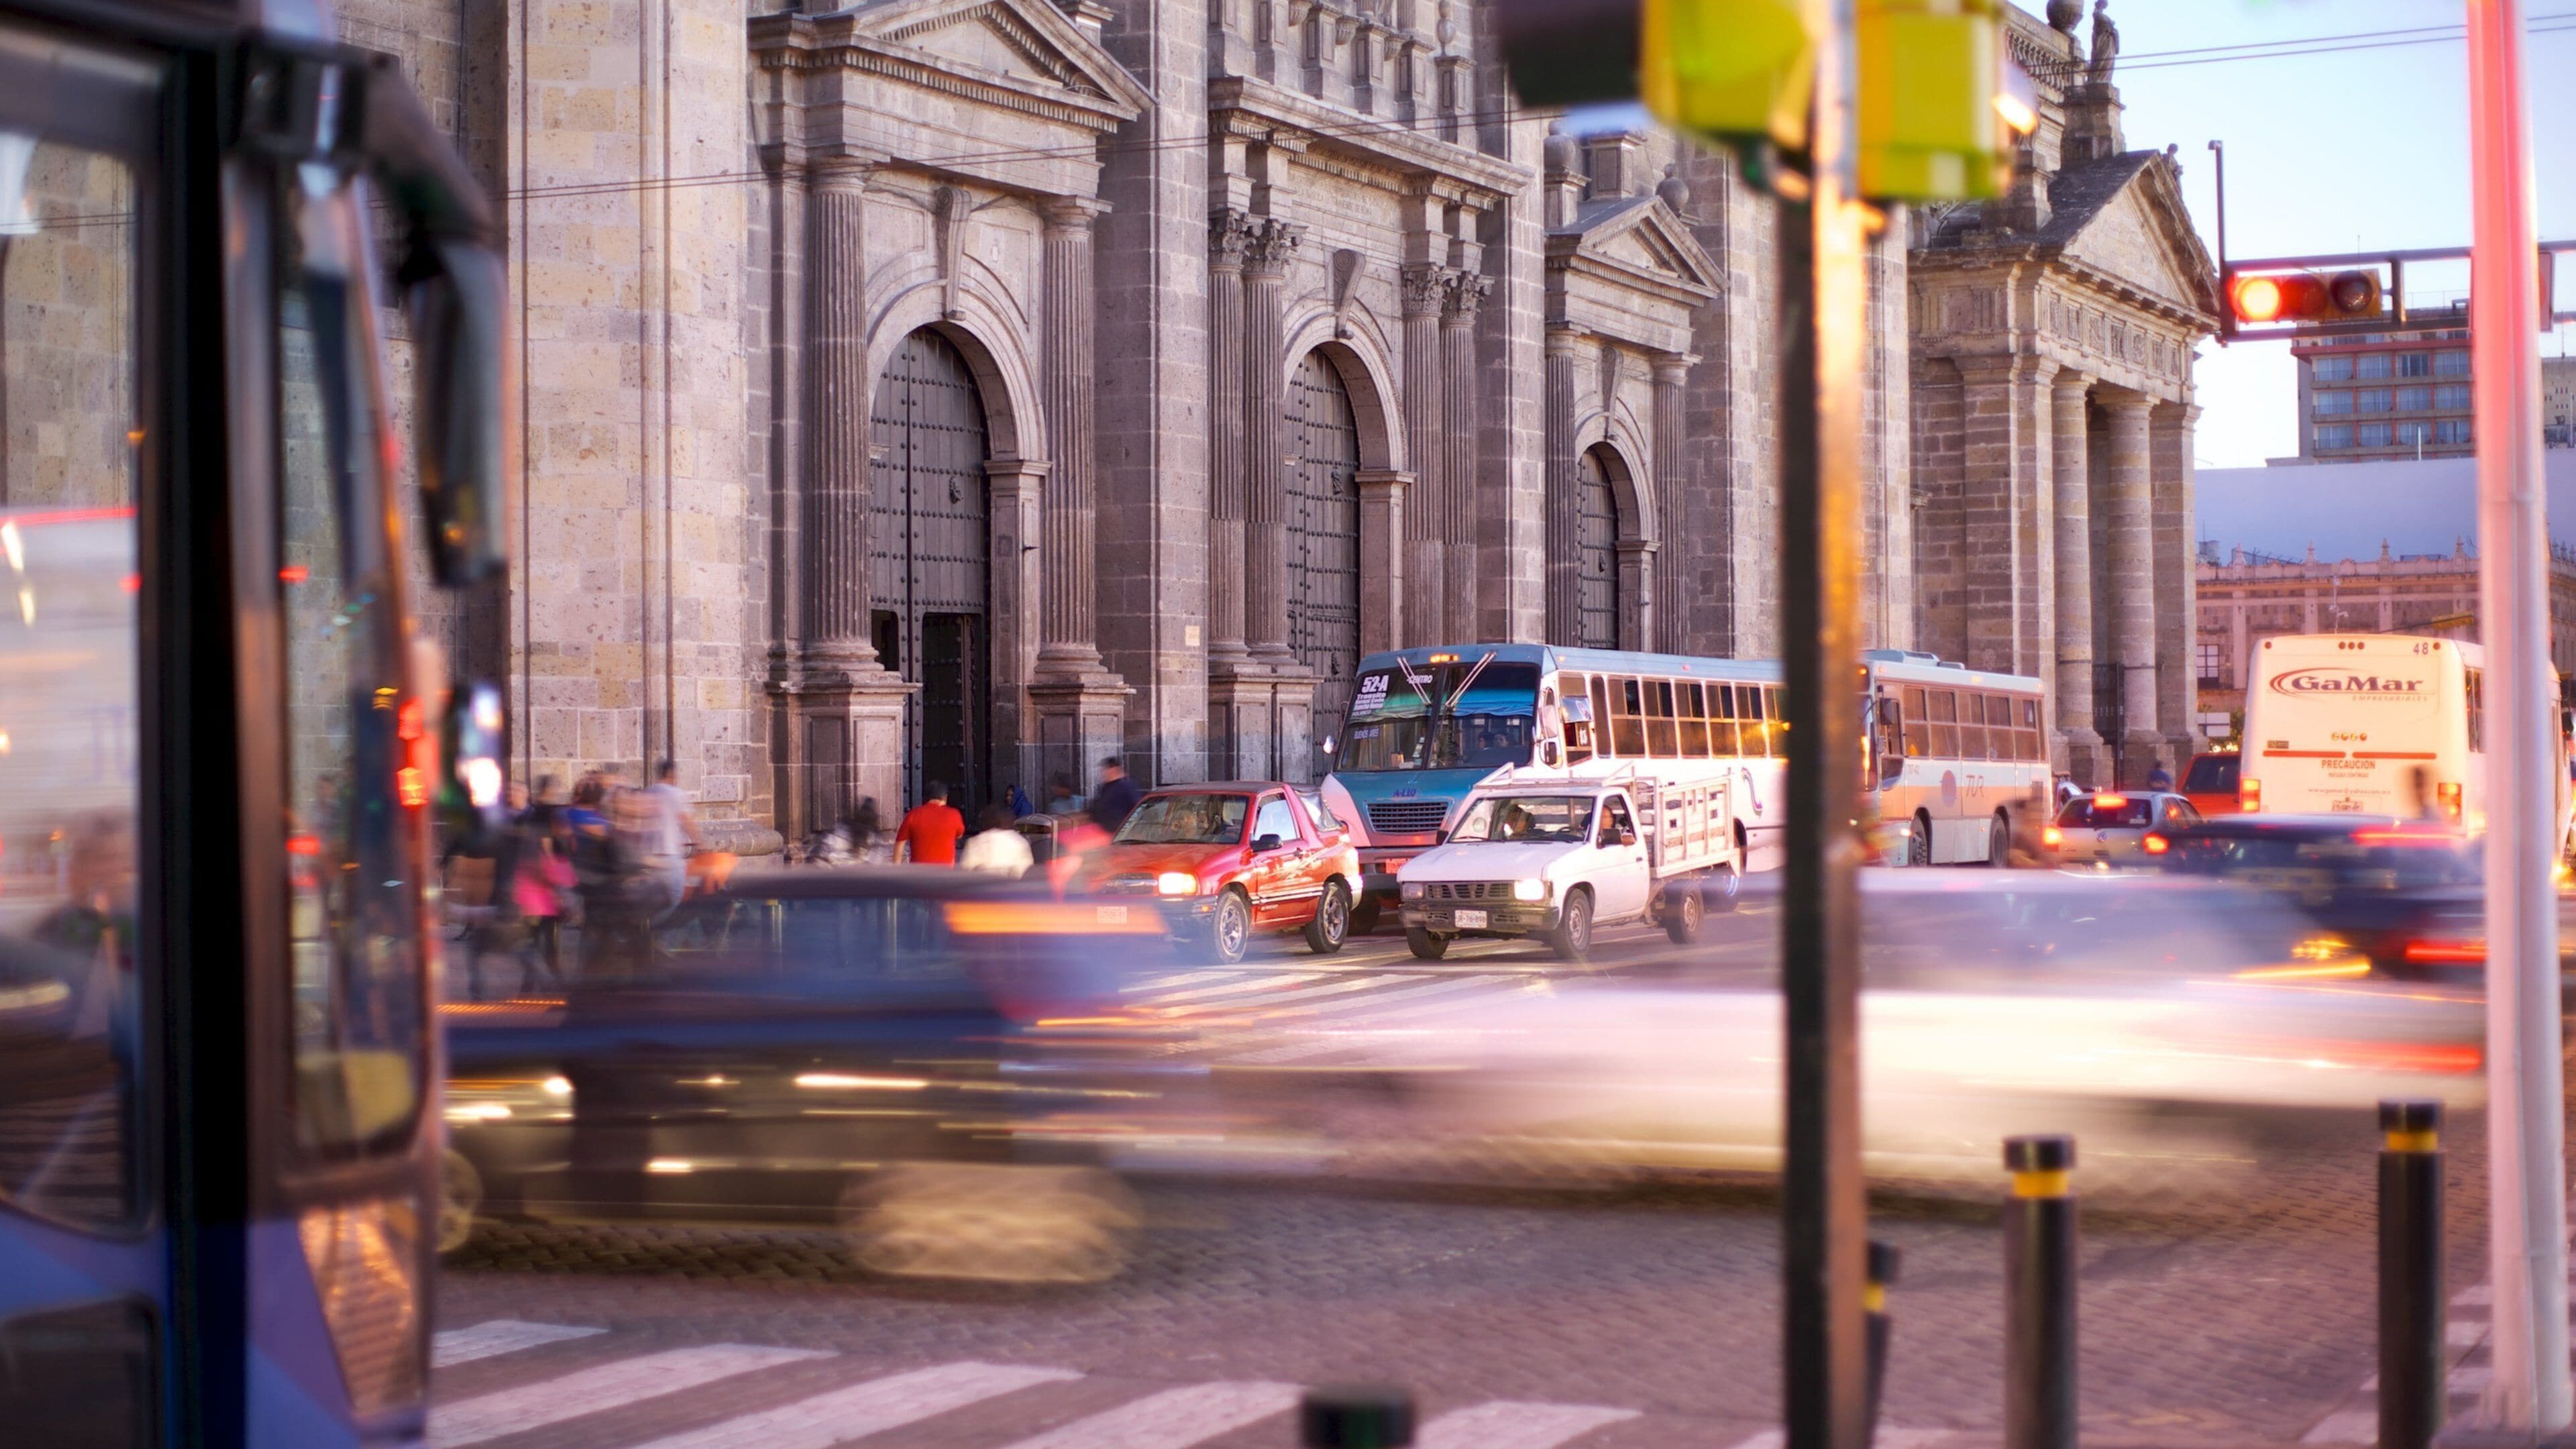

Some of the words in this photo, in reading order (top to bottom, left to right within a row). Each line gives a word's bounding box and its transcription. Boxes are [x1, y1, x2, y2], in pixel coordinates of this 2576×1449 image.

[2413, 642, 2429, 655] 48
[2291, 676, 2424, 692] GaMar
[2321, 759, 2376, 769] PRECAUCION
